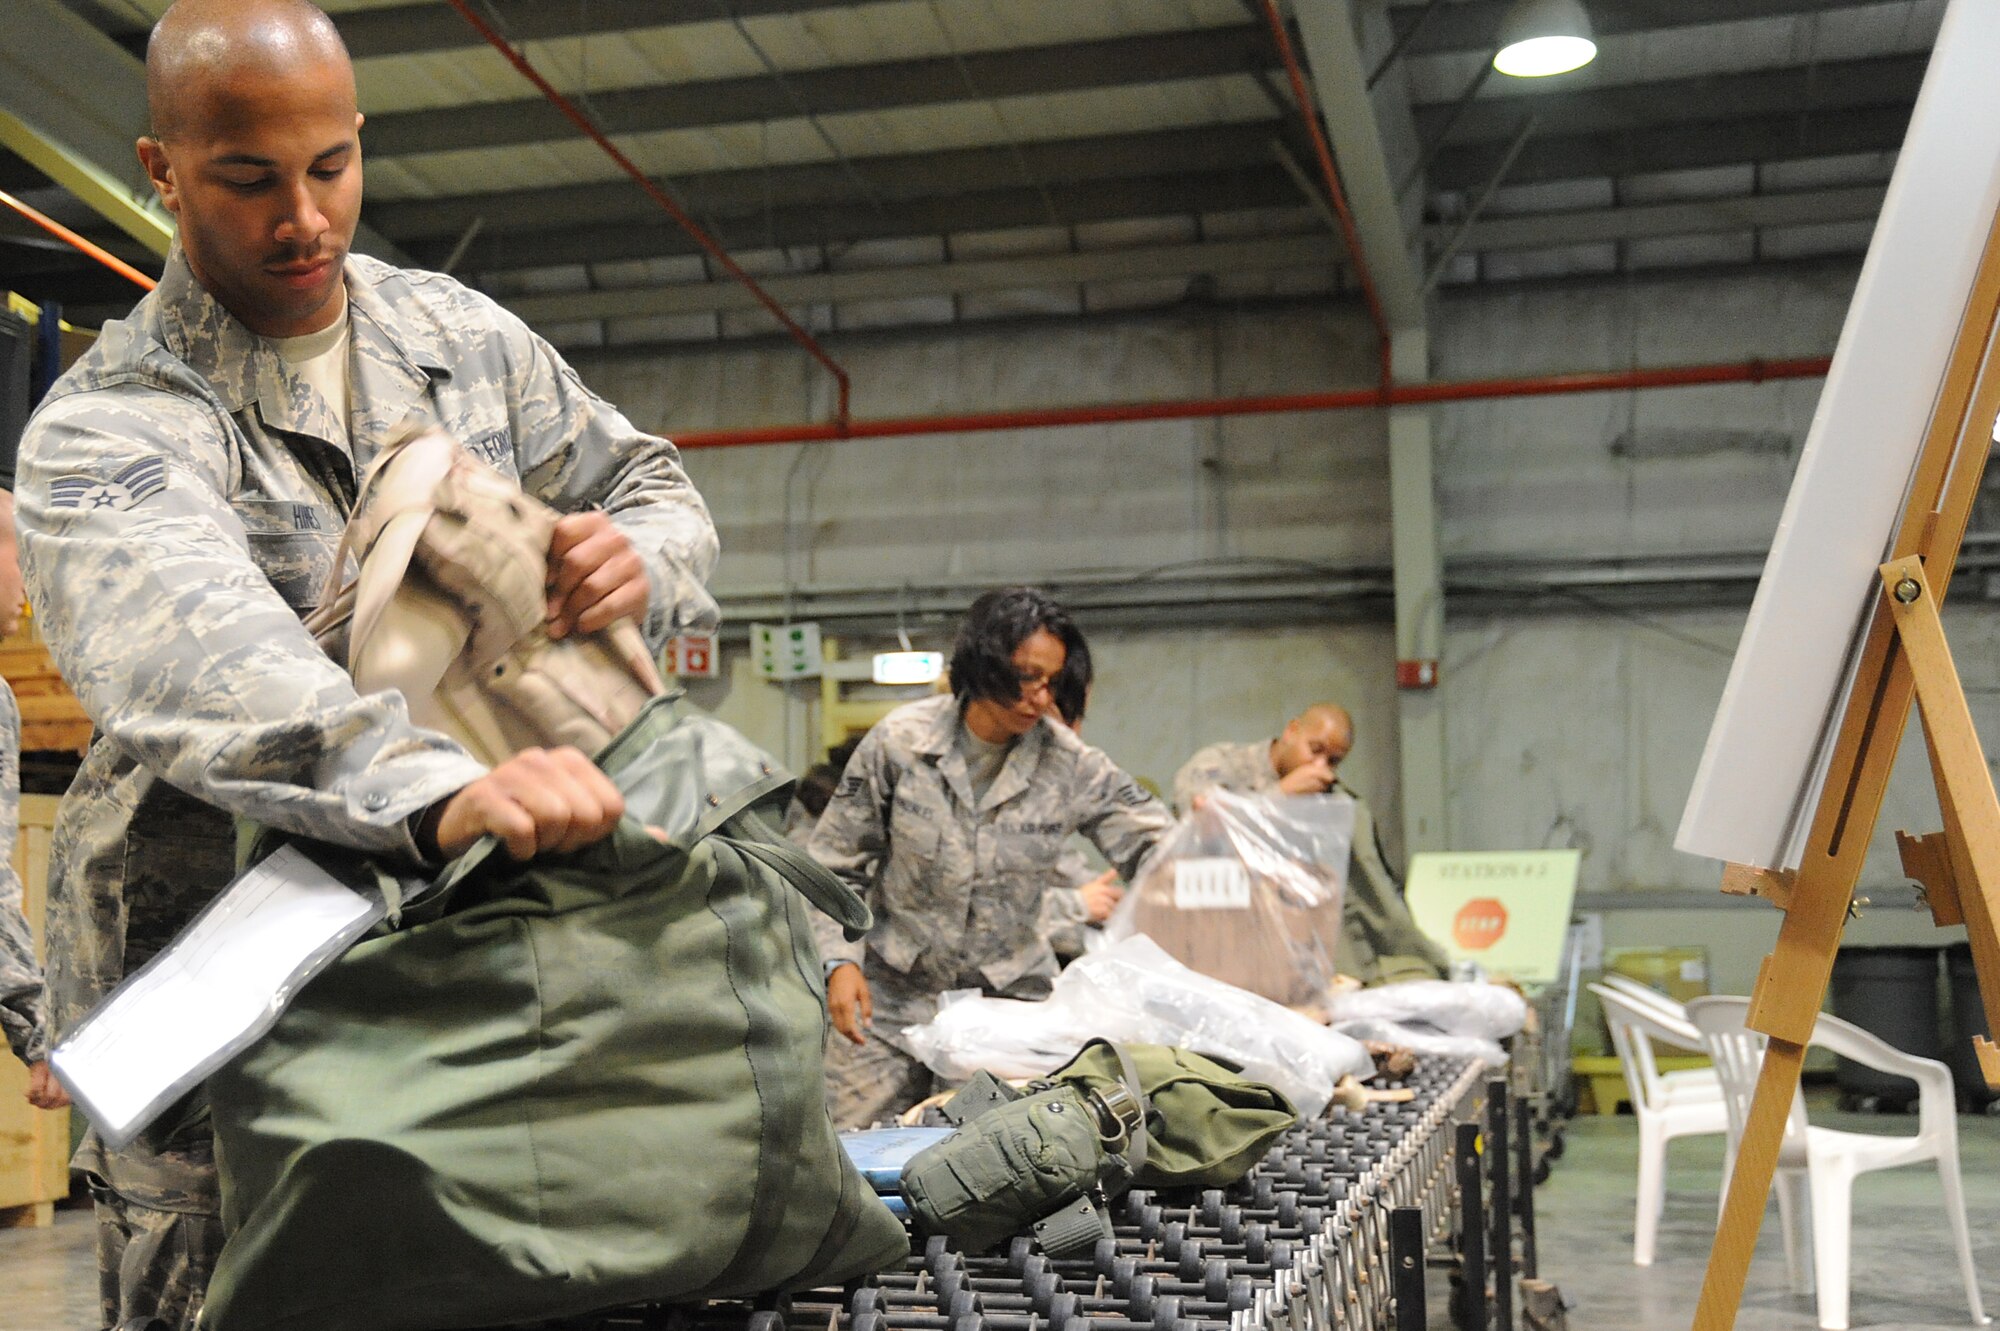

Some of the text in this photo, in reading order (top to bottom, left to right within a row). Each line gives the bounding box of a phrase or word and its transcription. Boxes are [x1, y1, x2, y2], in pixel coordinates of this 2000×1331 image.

[292, 503, 321, 530] HINES
[1438, 862, 1518, 879] STATION
[1460, 915, 1501, 932] STOP
